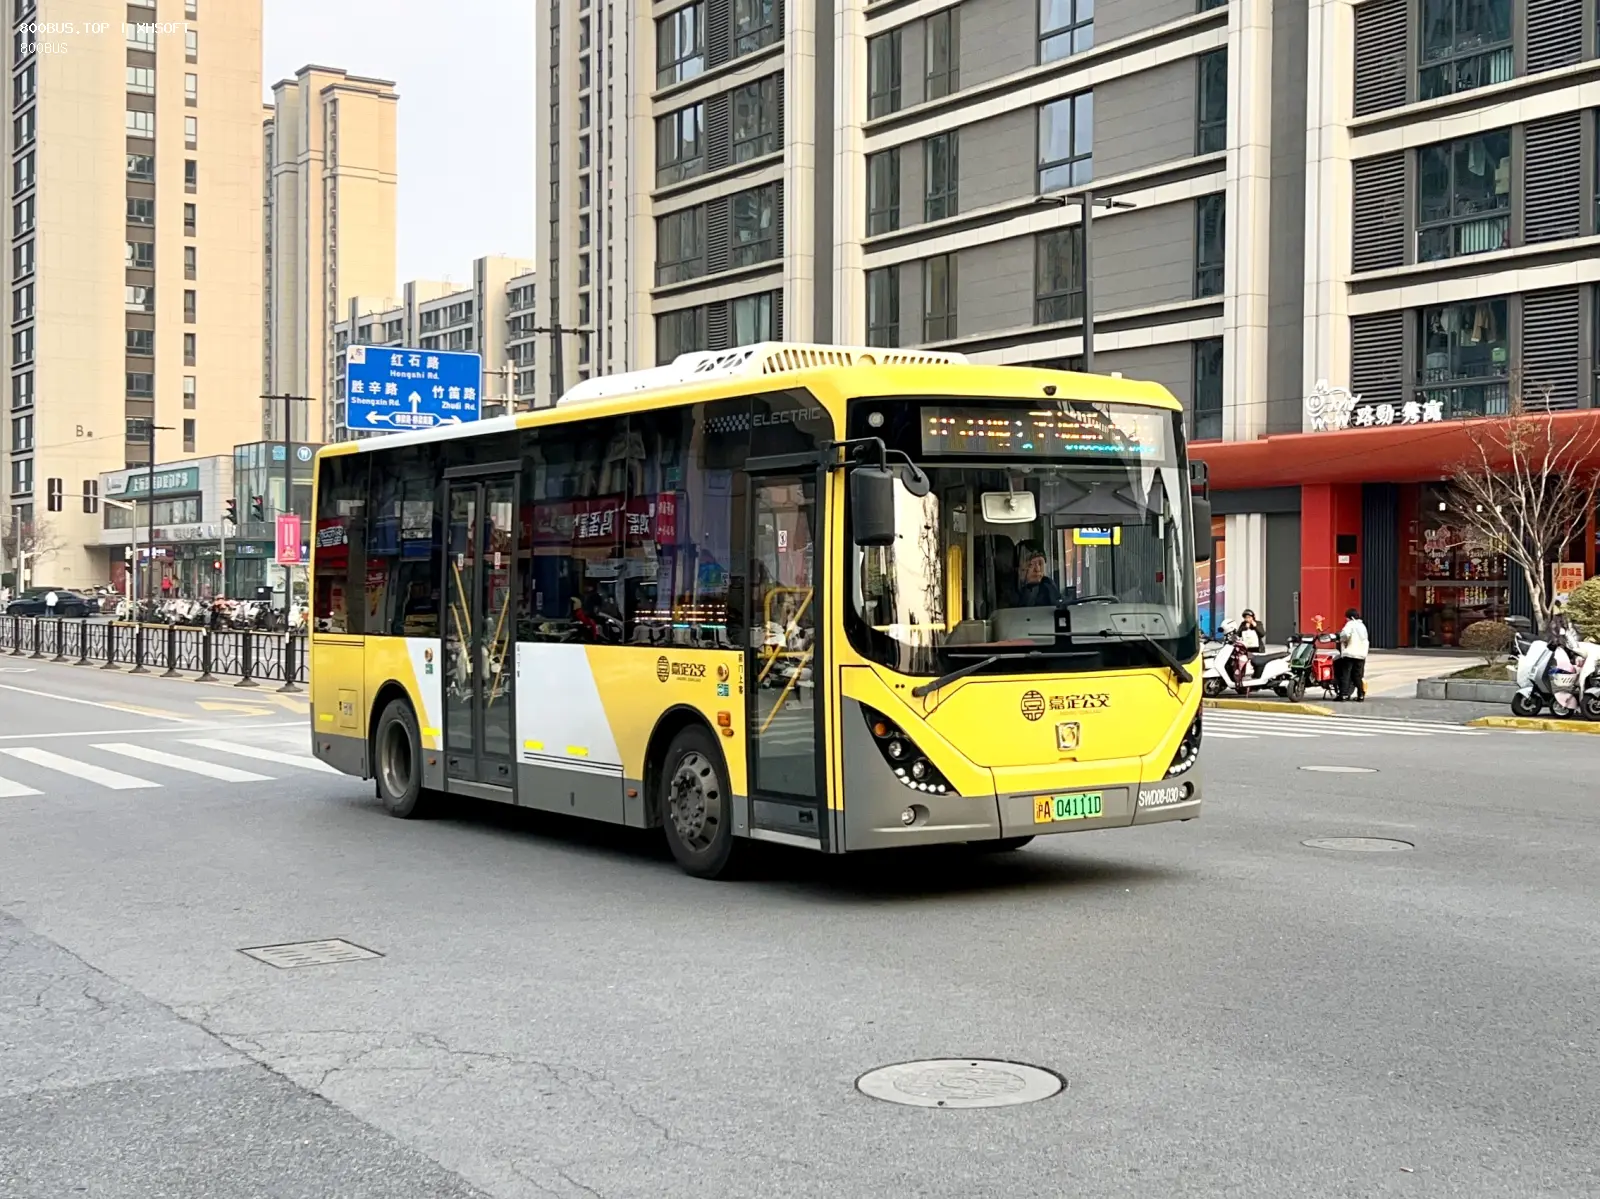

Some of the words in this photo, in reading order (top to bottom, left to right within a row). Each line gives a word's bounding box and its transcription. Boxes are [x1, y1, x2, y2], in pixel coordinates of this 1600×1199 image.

[391, 353, 439, 370] 红石路
[390, 369, 425, 379] Hongshi
[427, 371, 440, 380] Rd.
[351, 379, 398, 396] 胜辛路
[431, 384, 476, 401] 竹笛路
[351, 396, 387, 406] Shengxin
[389, 398, 401, 406] Rd.
[441, 400, 462, 410] Zhudi
[464, 402, 477, 410] Rd.
[753, 407, 821, 426] ELECTRIC
[671, 662, 706, 677] 嘉定公交
[1048, 693, 1111, 710] 嘉定公交
[1056, 795, 1102, 817] 04111D
